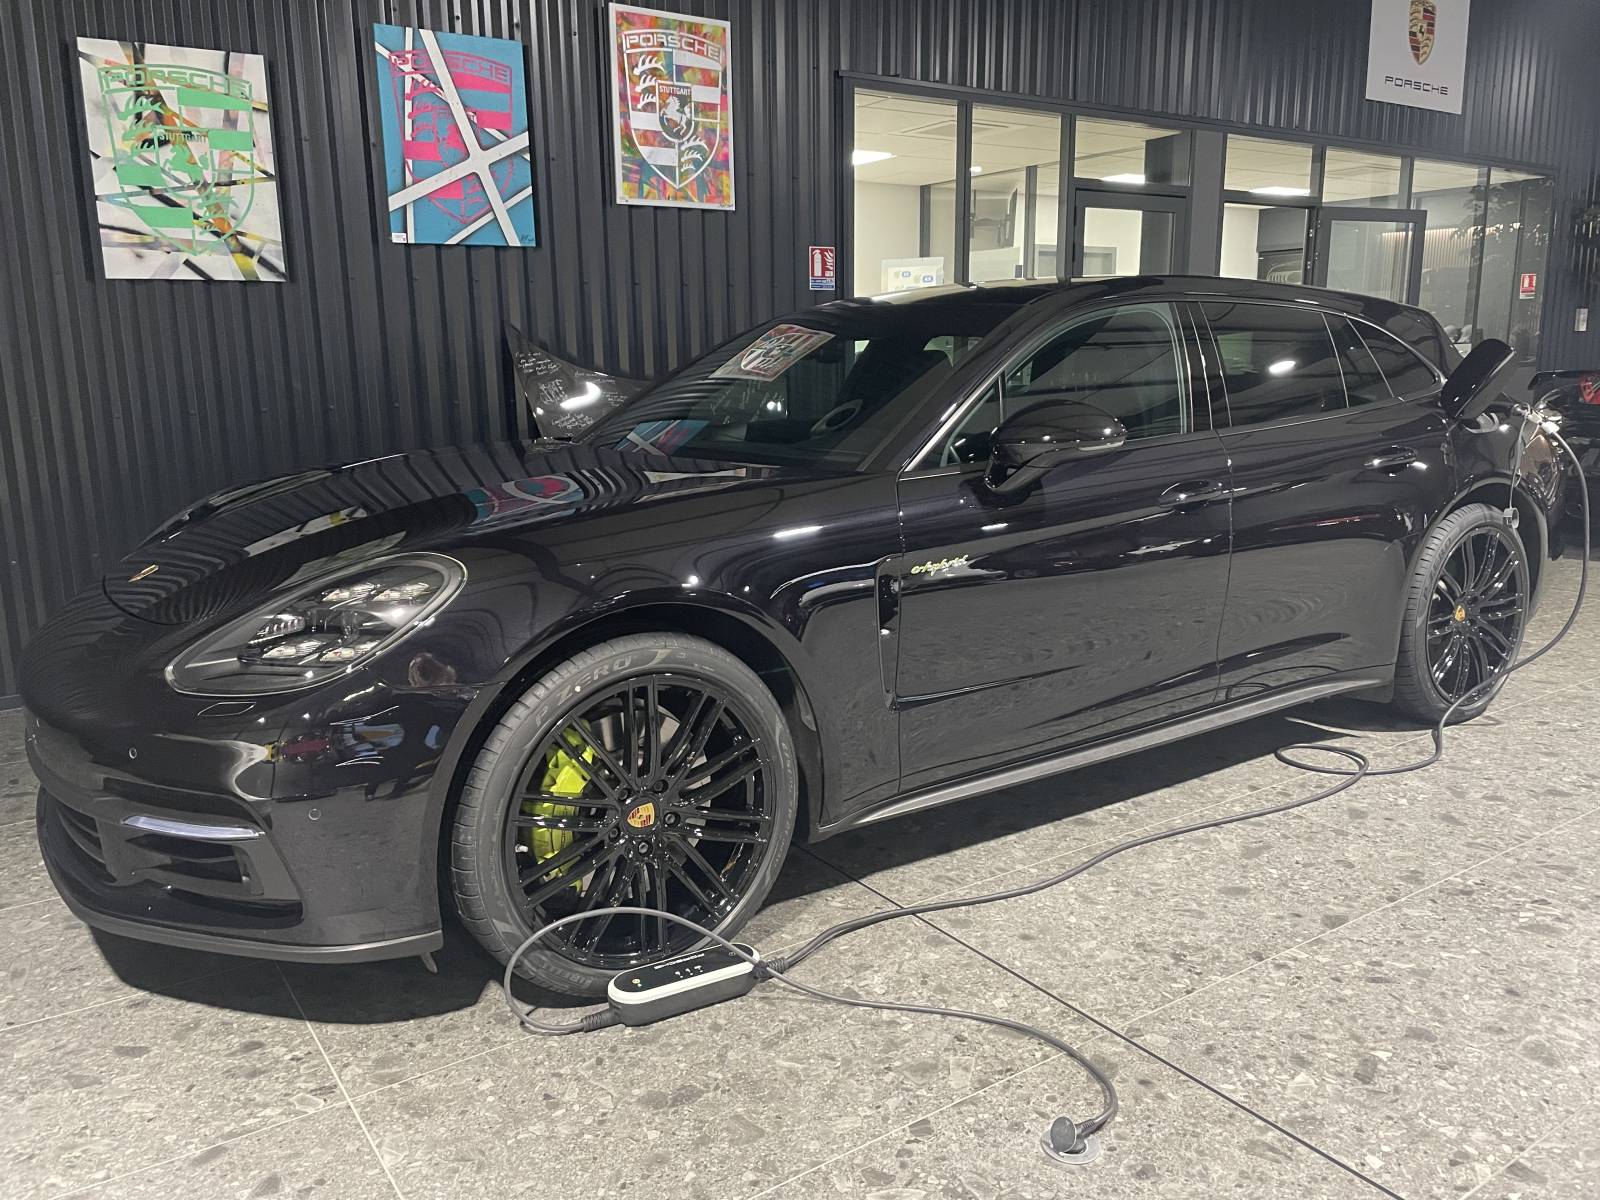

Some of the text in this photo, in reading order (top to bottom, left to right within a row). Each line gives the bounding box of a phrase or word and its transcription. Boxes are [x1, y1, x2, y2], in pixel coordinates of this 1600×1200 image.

[626, 33, 720, 62] PORSCHE
[390, 53, 511, 83] POSCHE
[104, 68, 250, 100] PORSCHE
[659, 85, 691, 96] STUTTGART
[1384, 75, 1449, 96] PORSCHE
[556, 655, 633, 706] ZERO
